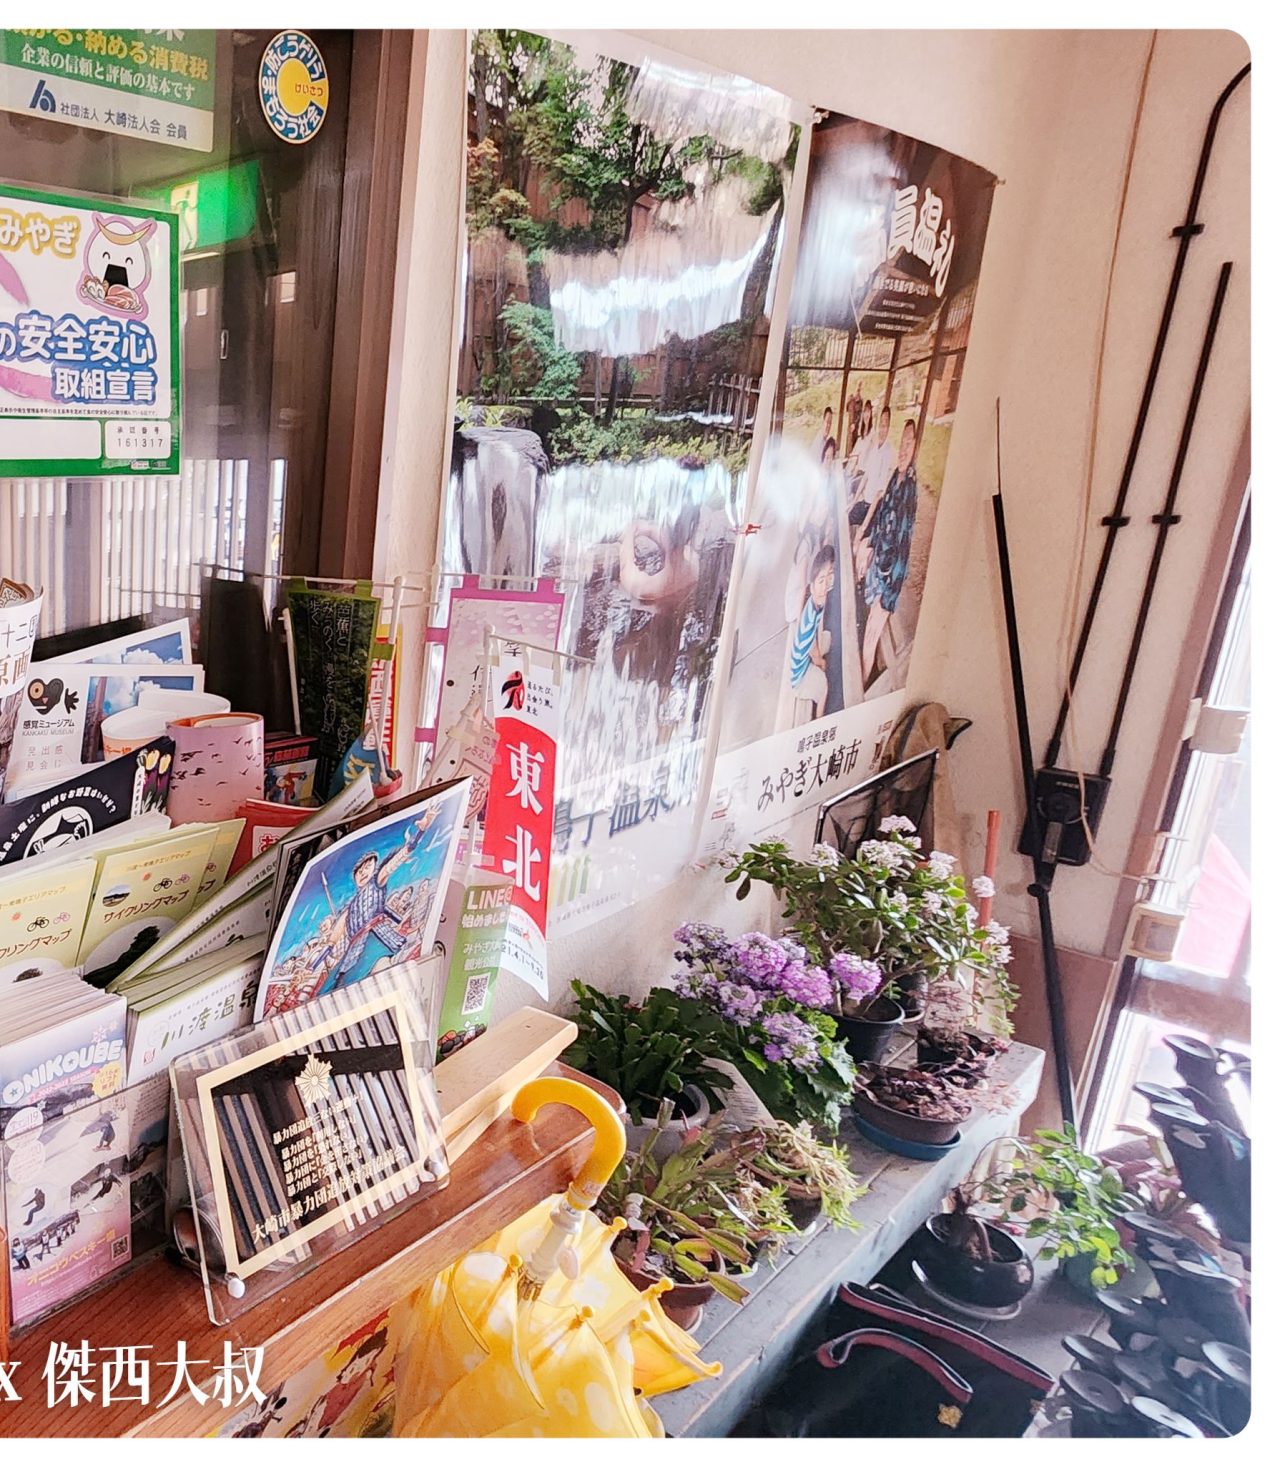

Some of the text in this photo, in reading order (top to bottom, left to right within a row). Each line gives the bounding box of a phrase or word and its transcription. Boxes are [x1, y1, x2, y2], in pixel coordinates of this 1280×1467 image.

[20, 43, 195, 100] 企業の信頼と評価の基本です
[295, 83, 323, 97] けいさつ
[60, 103, 100, 121] 社団法人
[166, 122, 187, 139] 会員
[53, 366, 155, 402] 取組宣言
[116, 438, 164, 448] 161317
[22, 719, 75, 730] 感覚ミュージアム
[757, 738, 862, 812] みやぎ大崎市
[502, 741, 546, 902] 東北
[103, 889, 190, 924] サイクリングマップ
[2, 1039, 124, 1105] ONIKOUBE
